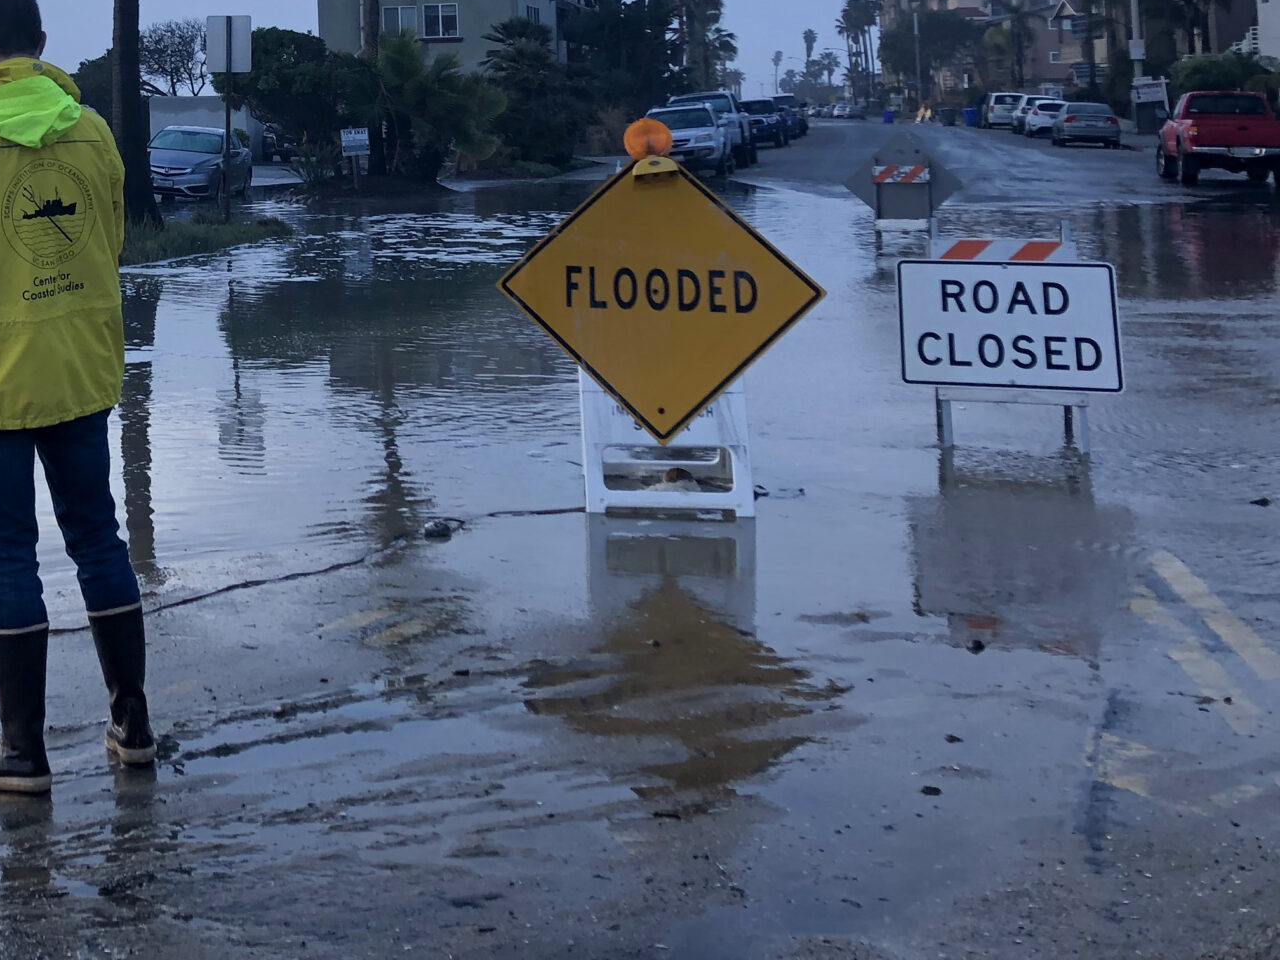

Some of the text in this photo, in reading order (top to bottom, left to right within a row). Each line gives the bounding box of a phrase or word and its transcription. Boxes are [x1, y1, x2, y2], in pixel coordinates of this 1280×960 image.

[12, 162, 44, 189] INSTITION
[22, 280, 85, 301] Coastal Sudies
[33, 275, 58, 287] Cente
[565, 265, 758, 314] FLOODED
[940, 279, 1070, 316] ROAD
[917, 331, 1103, 372] CLOSED
